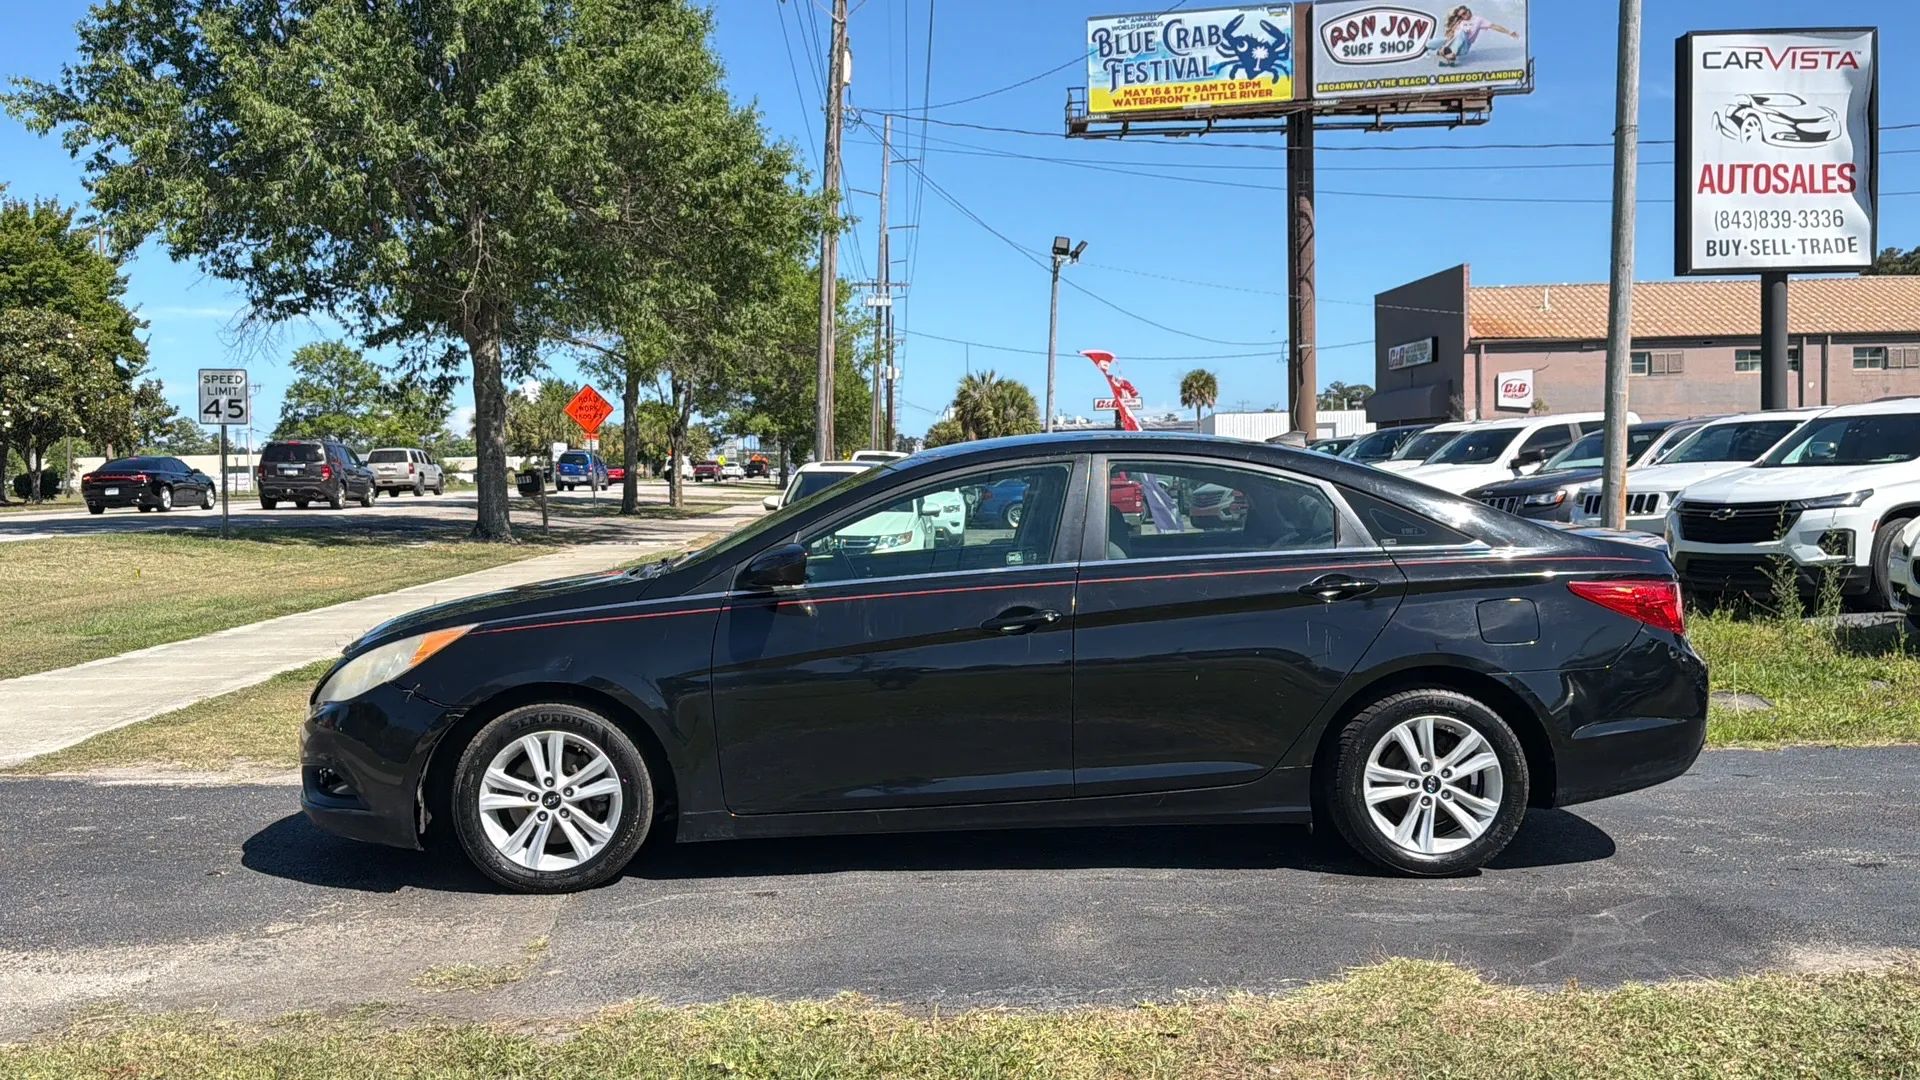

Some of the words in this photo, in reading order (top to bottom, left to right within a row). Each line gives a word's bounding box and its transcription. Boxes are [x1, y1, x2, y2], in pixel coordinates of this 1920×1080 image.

[1091, 27, 1155, 58] BLUE
[1162, 18, 1221, 57] CRAB
[1330, 15, 1376, 48] RON
[1380, 15, 1429, 40] JON
[1342, 42, 1374, 57] SURF
[1379, 40, 1415, 54] SHOP
[1103, 55, 1214, 92] FESTIVAL
[1317, 81, 1365, 92] BROADWAY
[1366, 80, 1378, 89] AT
[1380, 79, 1396, 88] THE
[1398, 77, 1428, 87] BEACH
[1429, 75, 1437, 84] &
[1438, 73, 1484, 83] BAREFOOT
[1485, 70, 1524, 80] LANDING
[1112, 94, 1190, 107] WATERFRONT
[1200, 91, 1237, 101] LITTLE
[1239, 88, 1273, 99] RIVER
[1123, 88, 1148, 98] MAY
[1150, 87, 1161, 95] 16
[1164, 86, 1171, 94] &
[1173, 85, 1184, 94] 17
[1194, 83, 1218, 93] 9AM
[1220, 82, 1236, 91] TO
[1238, 80, 1261, 90] 5PM
[1697, 163, 1857, 195] AUTOSALES
[1714, 209, 1845, 231] (843)839-3336
[203, 374, 244, 385] SPEED
[207, 386, 239, 396] LIMIT
[203, 398, 244, 418] 45
